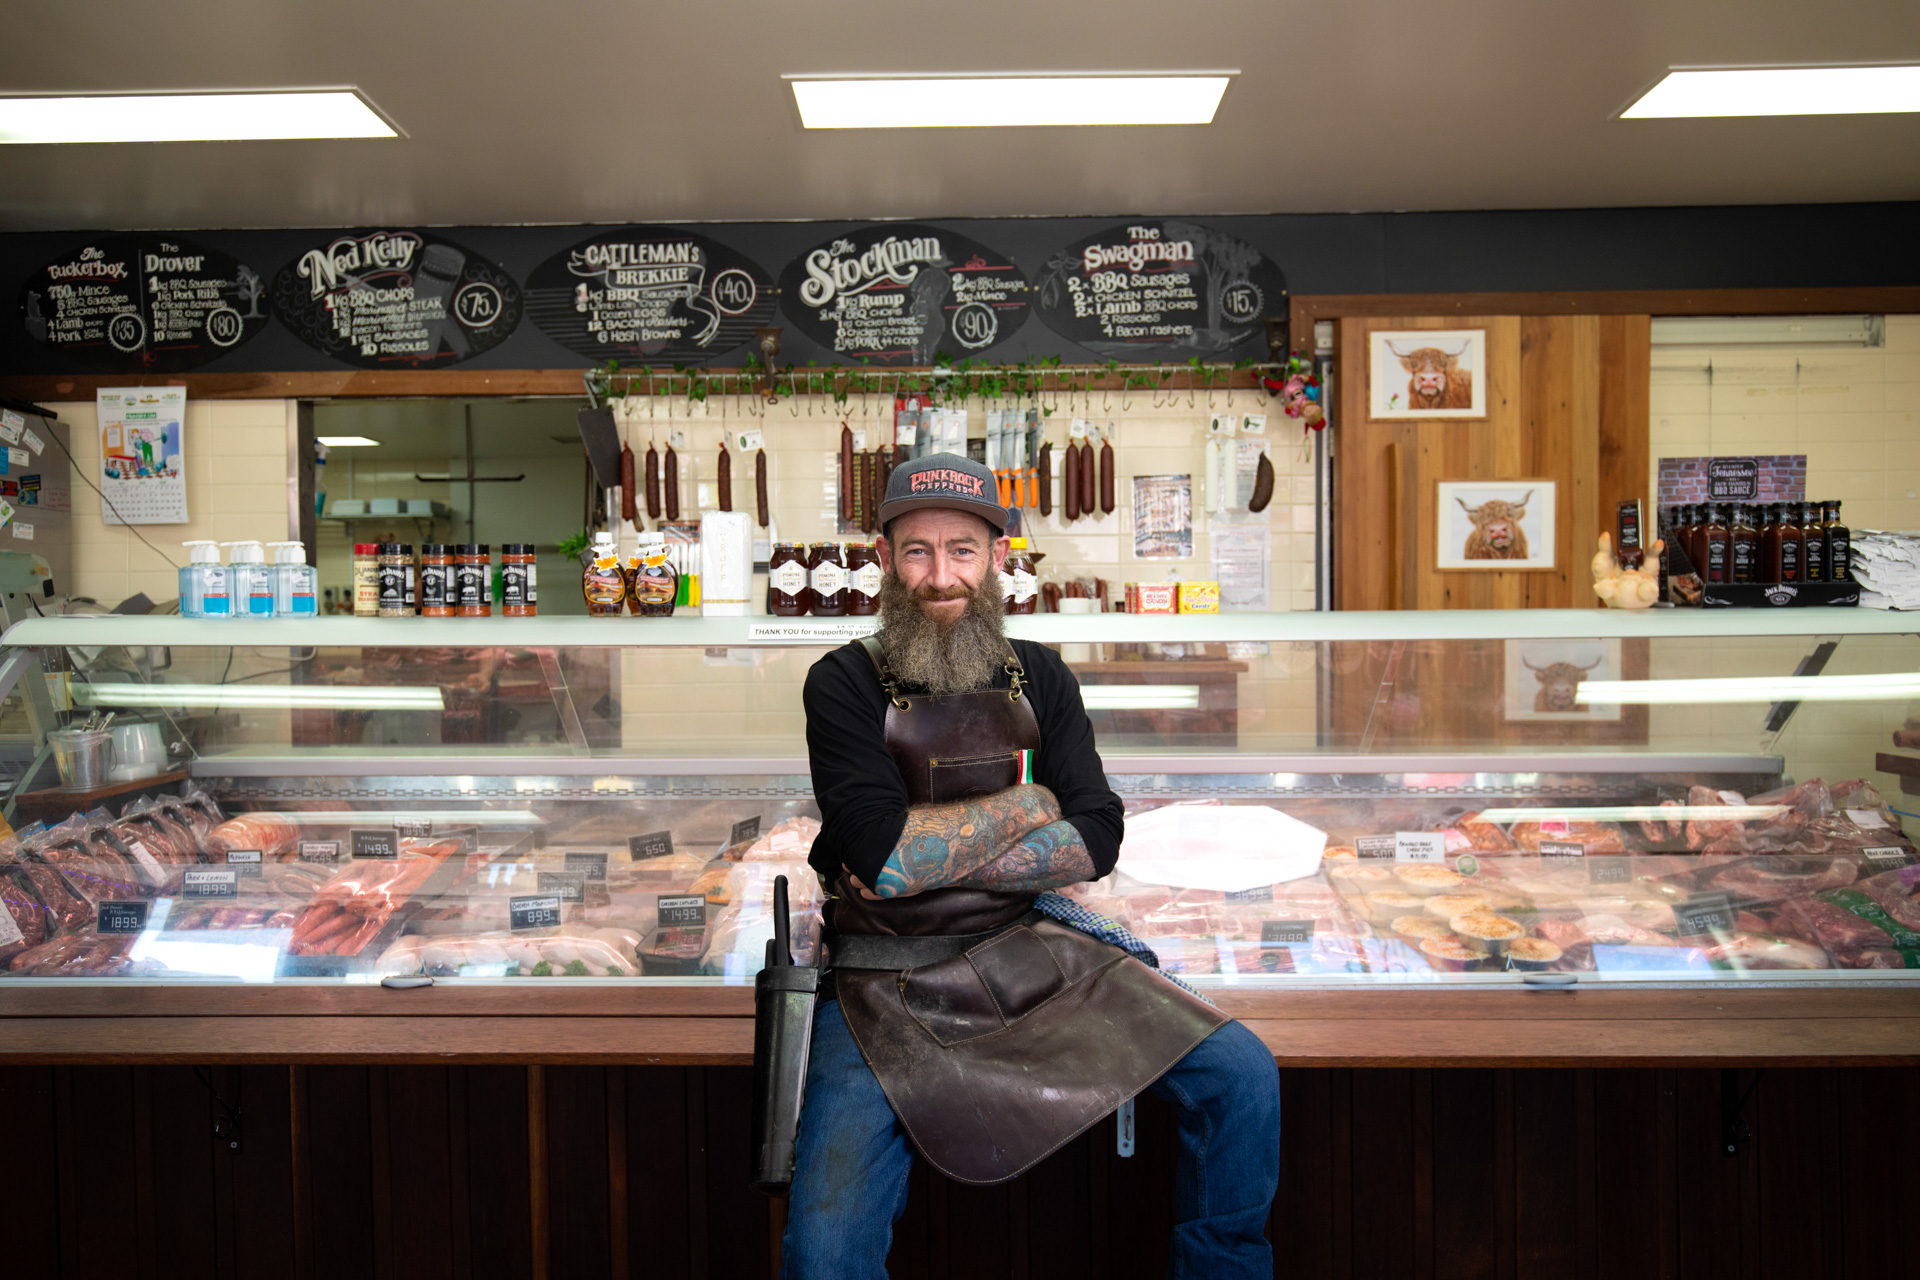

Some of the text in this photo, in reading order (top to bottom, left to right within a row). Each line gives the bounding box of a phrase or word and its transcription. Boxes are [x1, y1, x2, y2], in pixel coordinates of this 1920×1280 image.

[1127, 226, 1161, 240] The
[80, 247, 106, 261] The
[160, 243, 179, 252] The
[830, 237, 857, 257] The
[144, 254, 205, 273] Drover
[1083, 240, 1195, 273] Swagman
[48, 260, 129, 280] Tuckerbox
[296, 235, 417, 295] Ned Kelly
[799, 236, 943, 308] Stockman
[615, 267, 689, 285] BREKKIE
[1091, 271, 1129, 294] BBQ
[1130, 273, 1191, 290] Sausages
[78, 286, 111, 297] Mince
[376, 287, 415, 302] CHOPS
[607, 289, 640, 303] BBQ
[1094, 291, 1142, 303] CHICKEN
[1143, 288, 1197, 300] SCHNITZEL
[408, 296, 443, 312] STEAK
[858, 294, 905, 310] Rump
[1096, 301, 1142, 315] Lamb
[1143, 300, 1168, 312] BBQ
[634, 308, 667, 318] EGGS
[56, 317, 84, 330] Lamb
[605, 319, 645, 330] BACON
[1103, 323, 1114, 338] 4
[1116, 325, 1149, 337] Bacon
[57, 331, 82, 342] Pork
[611, 329, 640, 342] Hash
[641, 329, 682, 341] Browns
[361, 341, 430, 356] 10 RISSOLES
[1729, 486, 1751, 495] SAUCE
[813, 629, 854, 638] supporting
[855, 629, 871, 638] your
